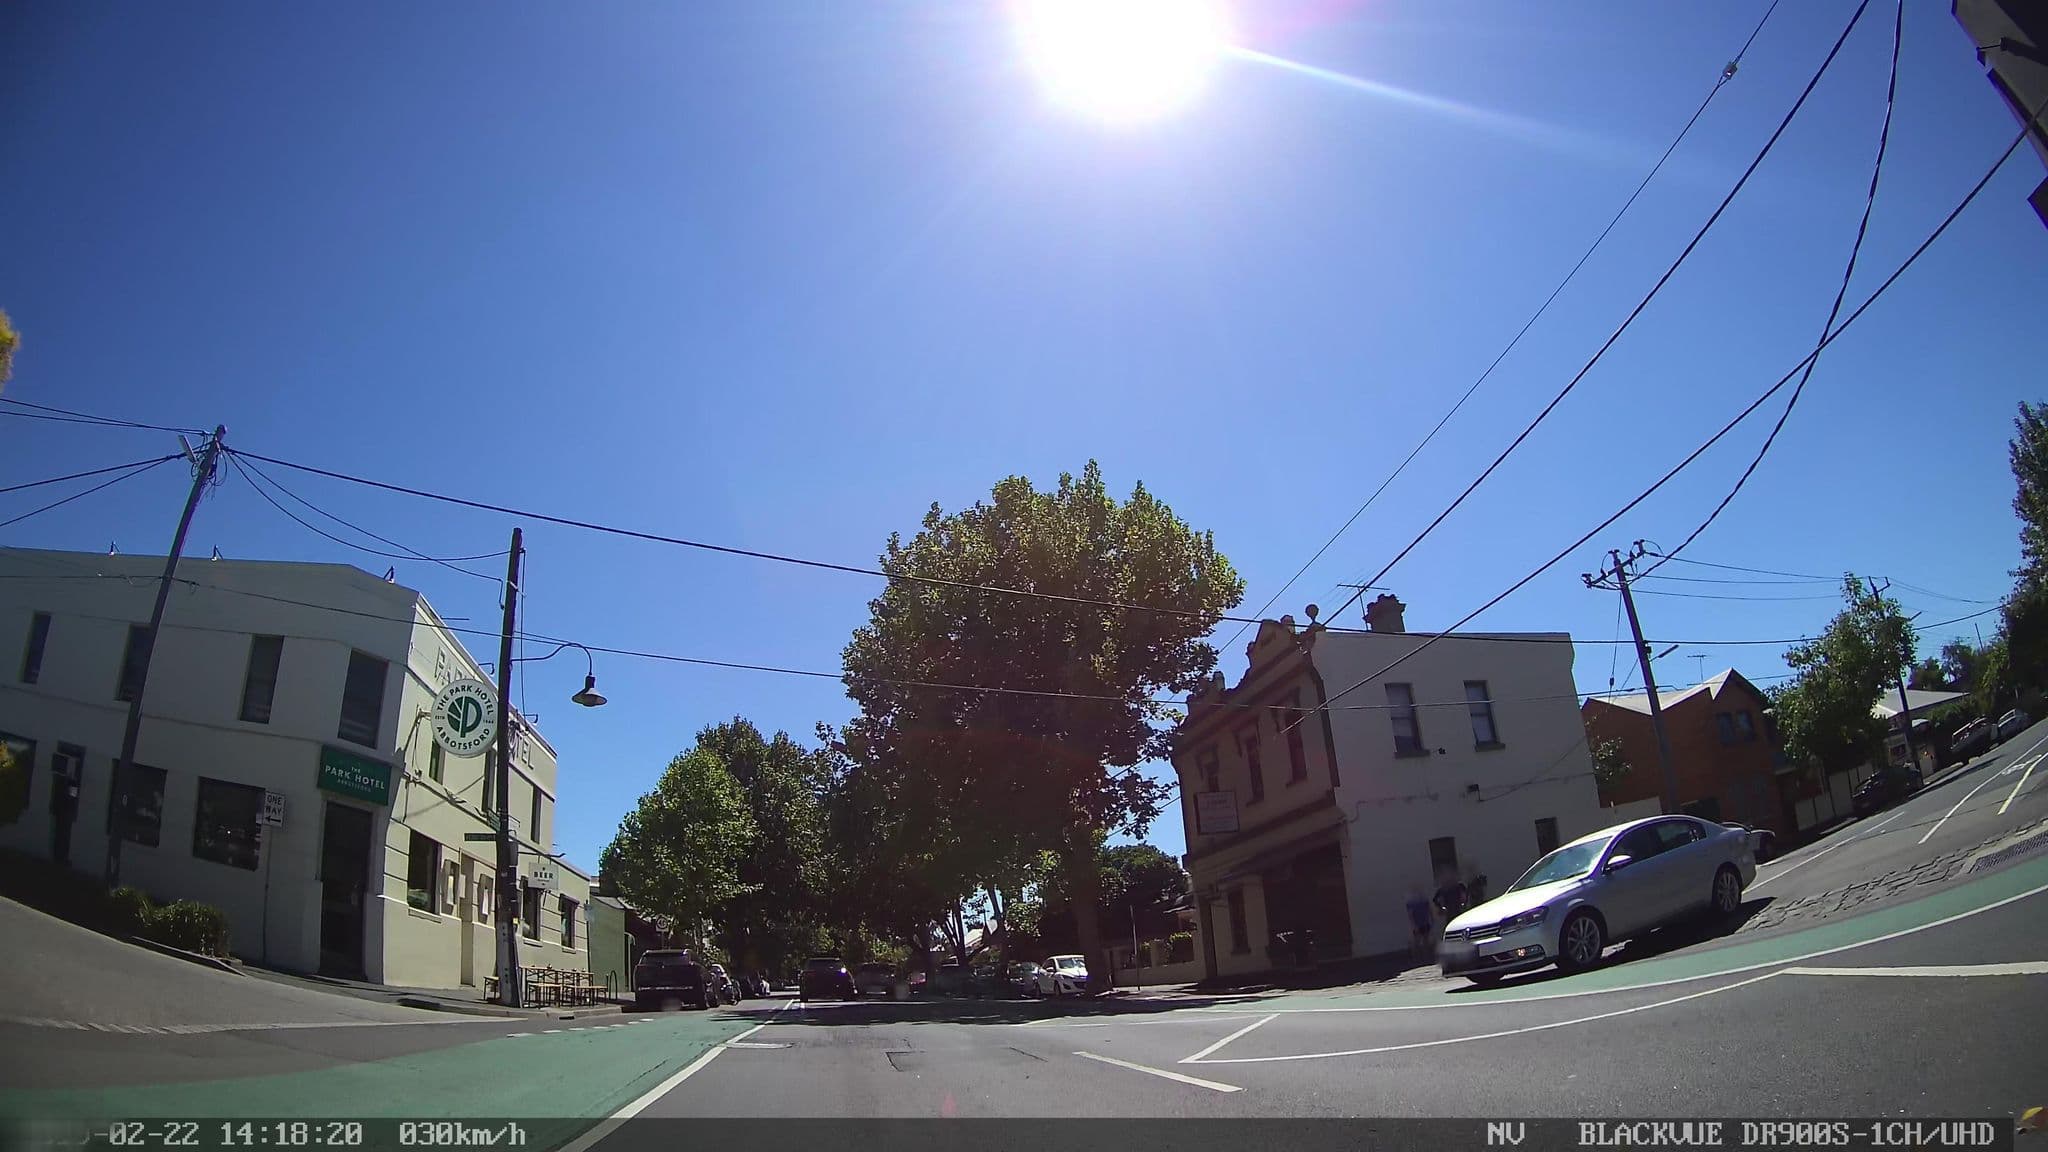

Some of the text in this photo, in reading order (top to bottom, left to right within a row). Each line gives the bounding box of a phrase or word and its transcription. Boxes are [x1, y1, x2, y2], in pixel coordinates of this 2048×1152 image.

[437, 685, 494, 716] THE PARK HOTEL
[436, 726, 490, 750] ABBOTSFORD
[325, 764, 352, 780] PARK
[354, 774, 385, 790] HOTEL
[266, 794, 282, 806] ONE
[265, 805, 282, 816] WAY
[533, 871, 554, 880] BEER
